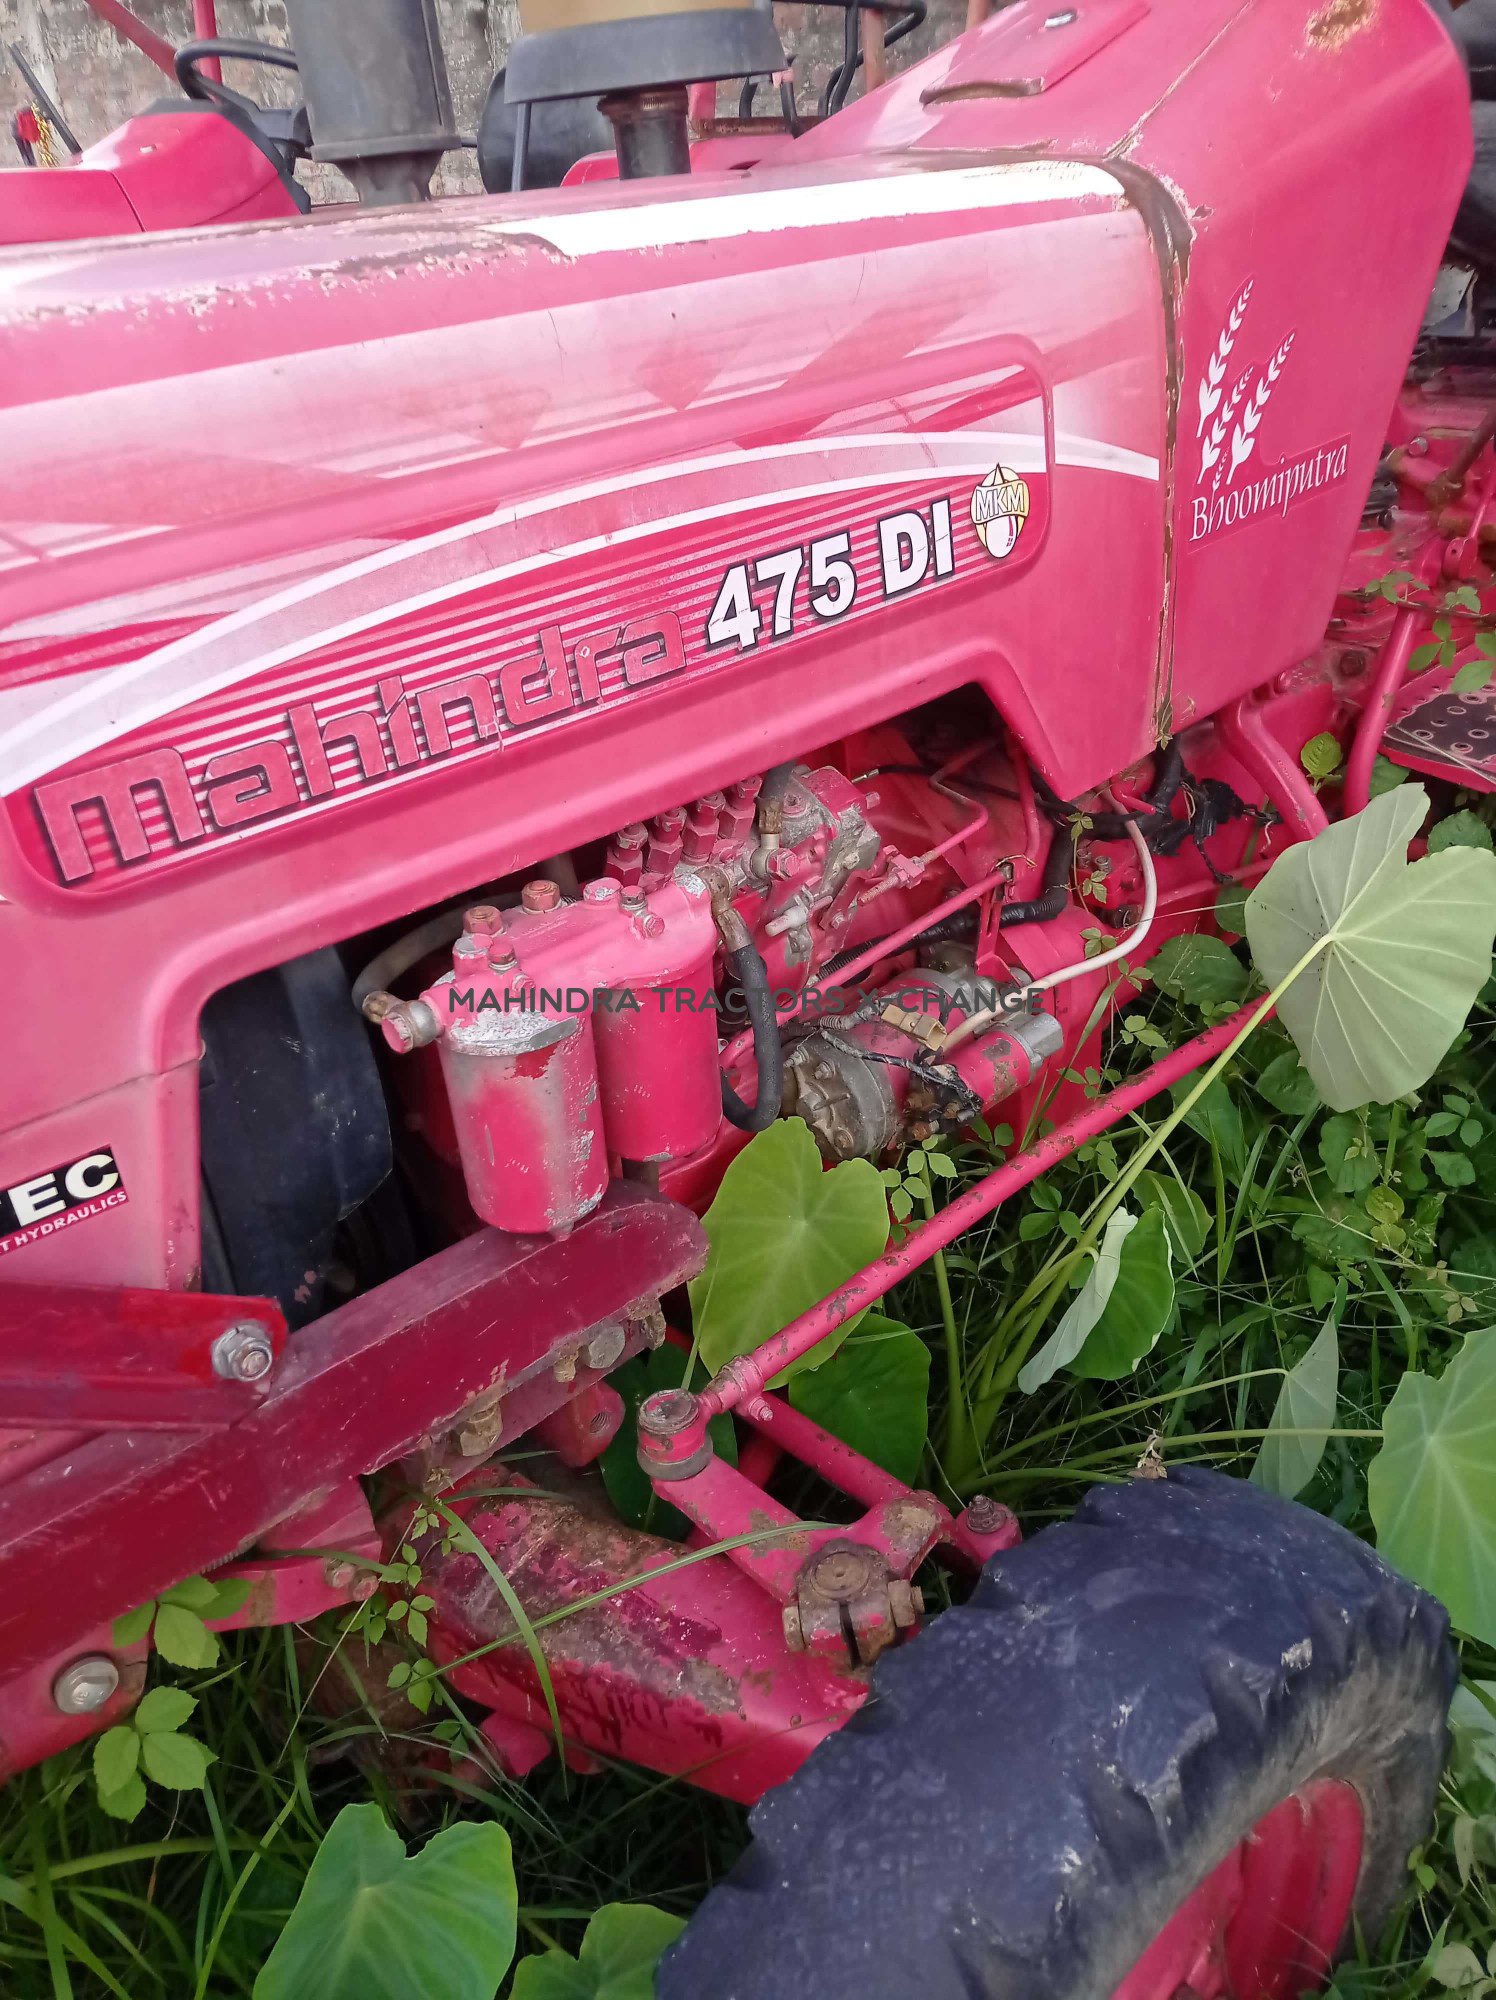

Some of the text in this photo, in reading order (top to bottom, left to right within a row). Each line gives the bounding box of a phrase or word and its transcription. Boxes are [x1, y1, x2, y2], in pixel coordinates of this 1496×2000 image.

[974, 482, 1026, 522] MKM
[1189, 443, 1348, 543] Bhoomiputra
[705, 530, 859, 652] 475
[876, 495, 955, 600] DI
[0, 1154, 119, 1227] EC
[14, 1191, 127, 1246] HYDRAULICS
